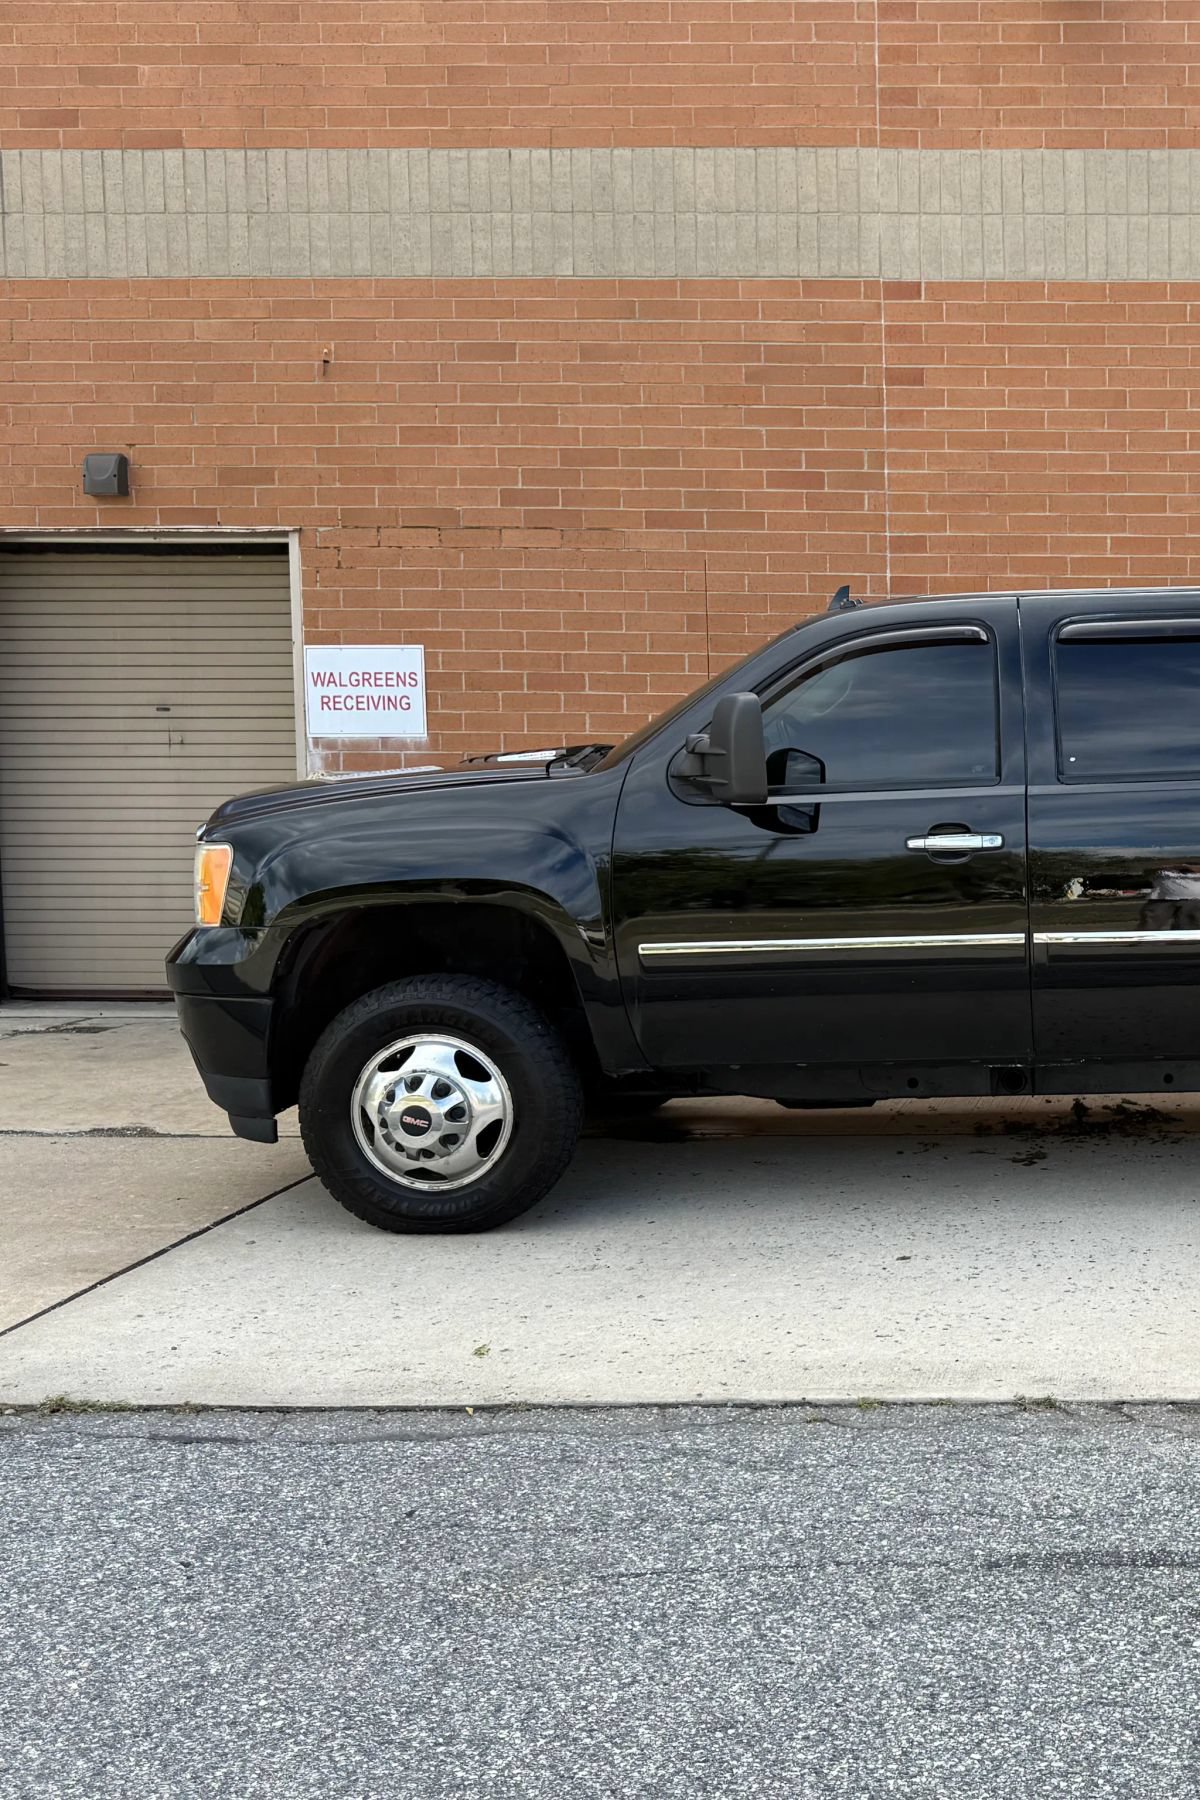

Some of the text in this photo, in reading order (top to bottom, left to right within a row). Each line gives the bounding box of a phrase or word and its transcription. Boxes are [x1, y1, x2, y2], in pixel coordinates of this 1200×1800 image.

[311, 671, 418, 688] WALGREENS
[320, 695, 411, 711] RECEIVING
[402, 1115, 429, 1128] GMC
